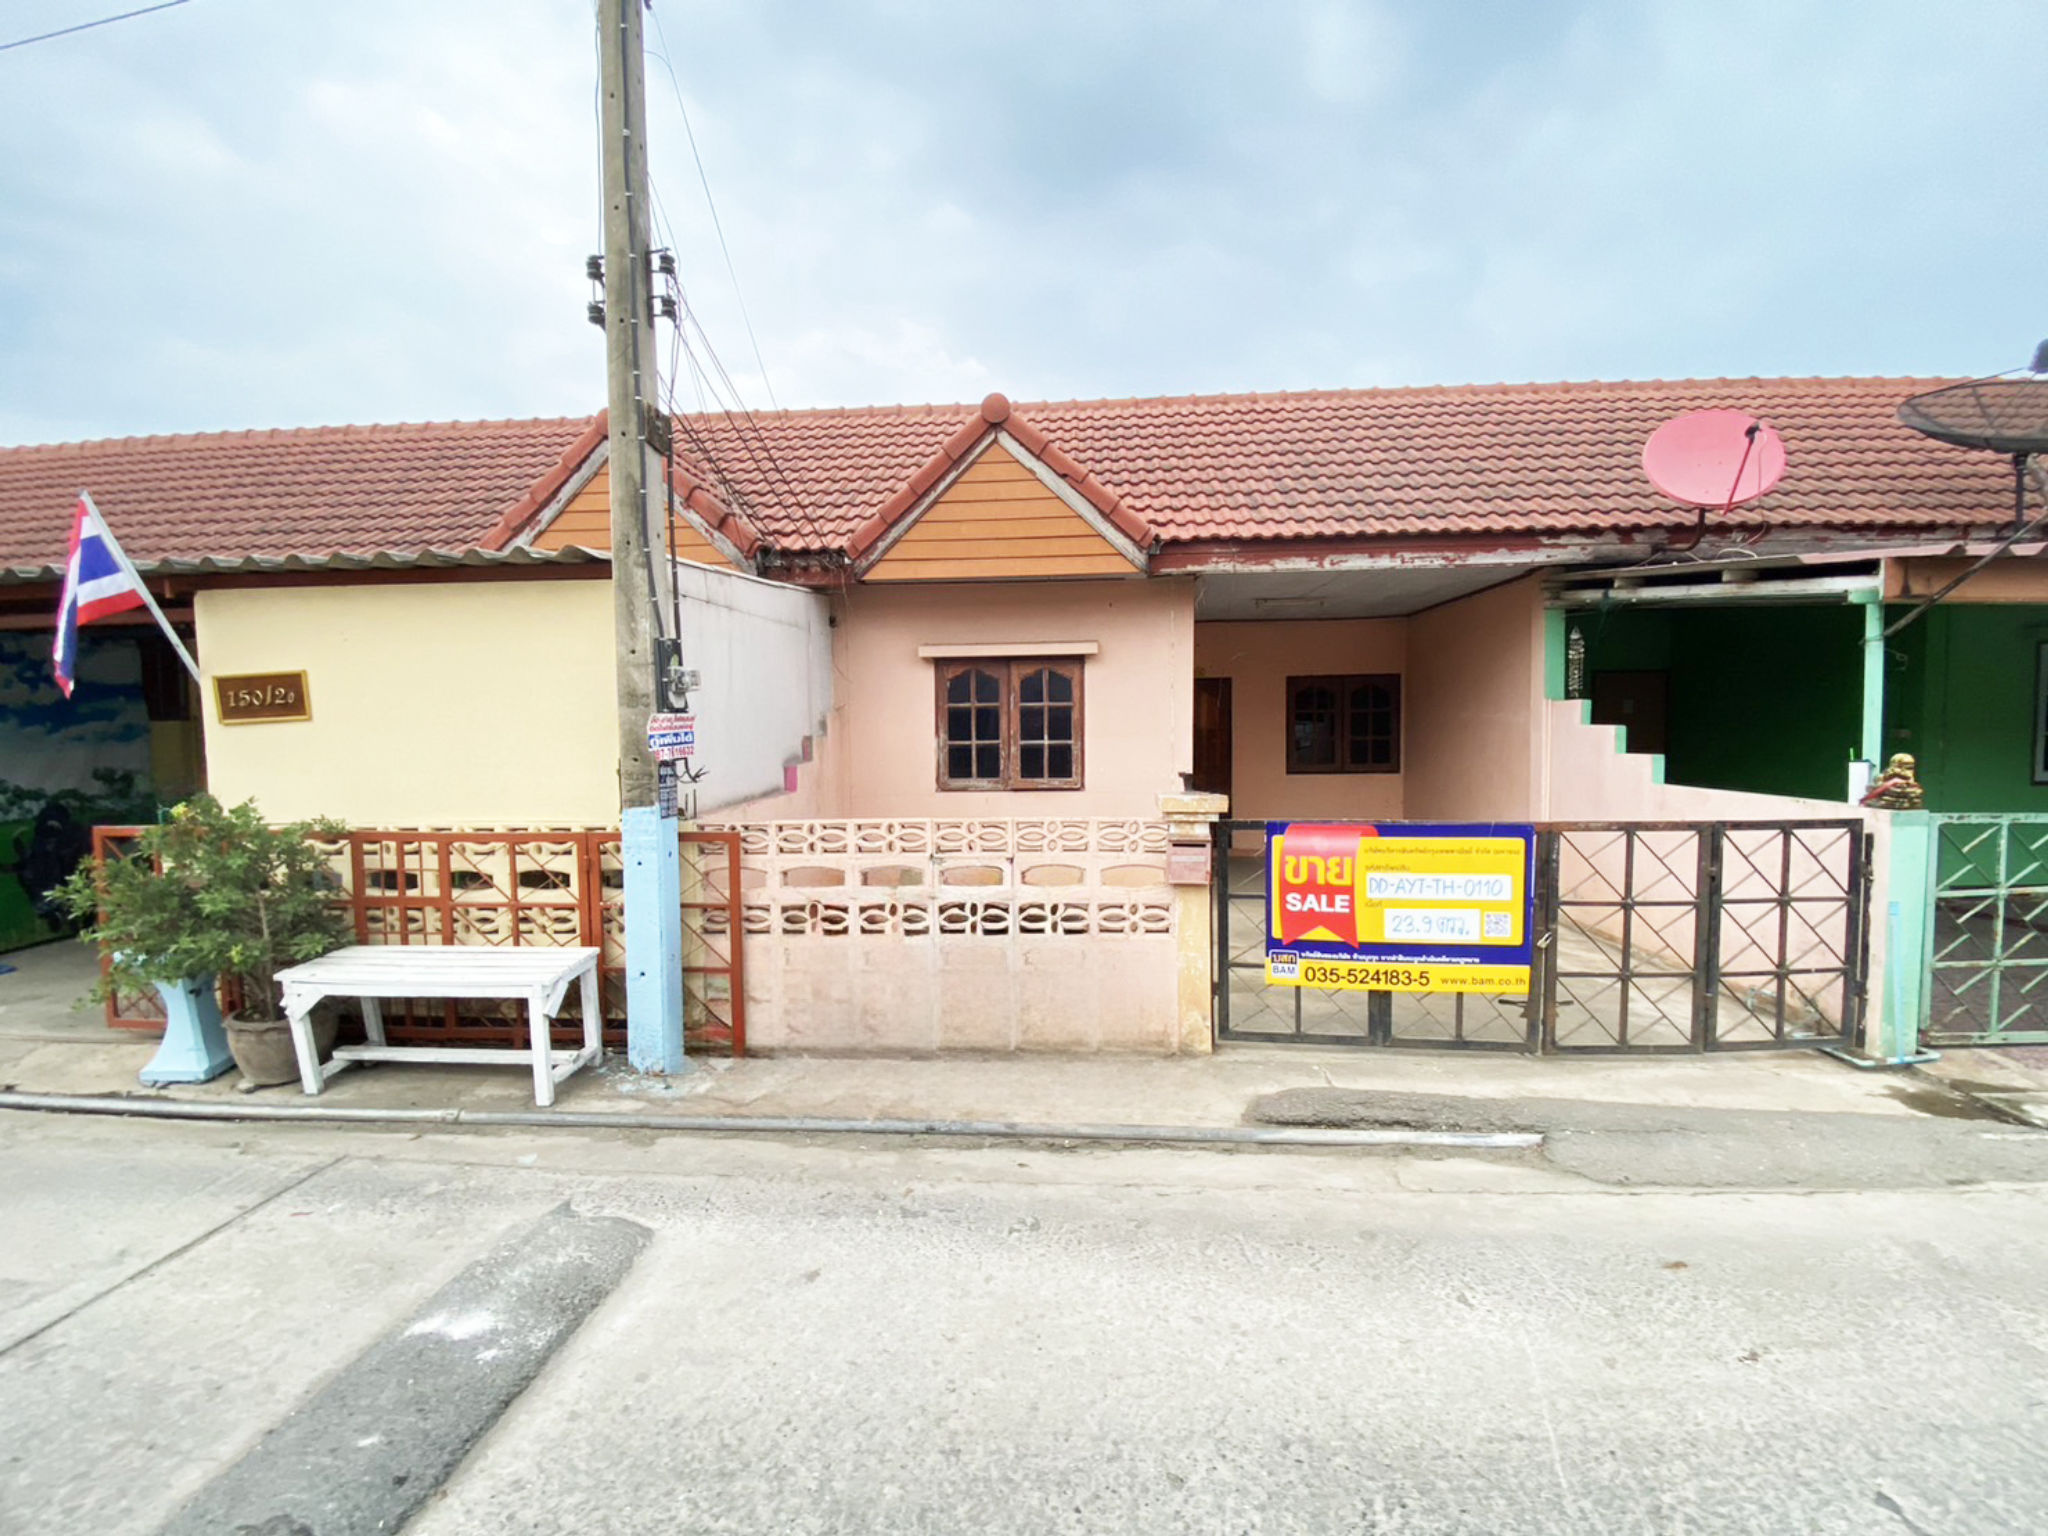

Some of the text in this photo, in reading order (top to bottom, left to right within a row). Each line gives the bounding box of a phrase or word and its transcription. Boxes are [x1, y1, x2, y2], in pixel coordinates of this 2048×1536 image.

[1284, 855, 1353, 887] ขาย
[1368, 876, 1504, 897] DD-AYT-TH-0110
[1285, 892, 1350, 913] SALE
[1392, 915, 1433, 934] 23.9
[1272, 965, 1296, 975] BAM
[1304, 966, 1526, 987] 035-524183-5 www.bam.co.th
